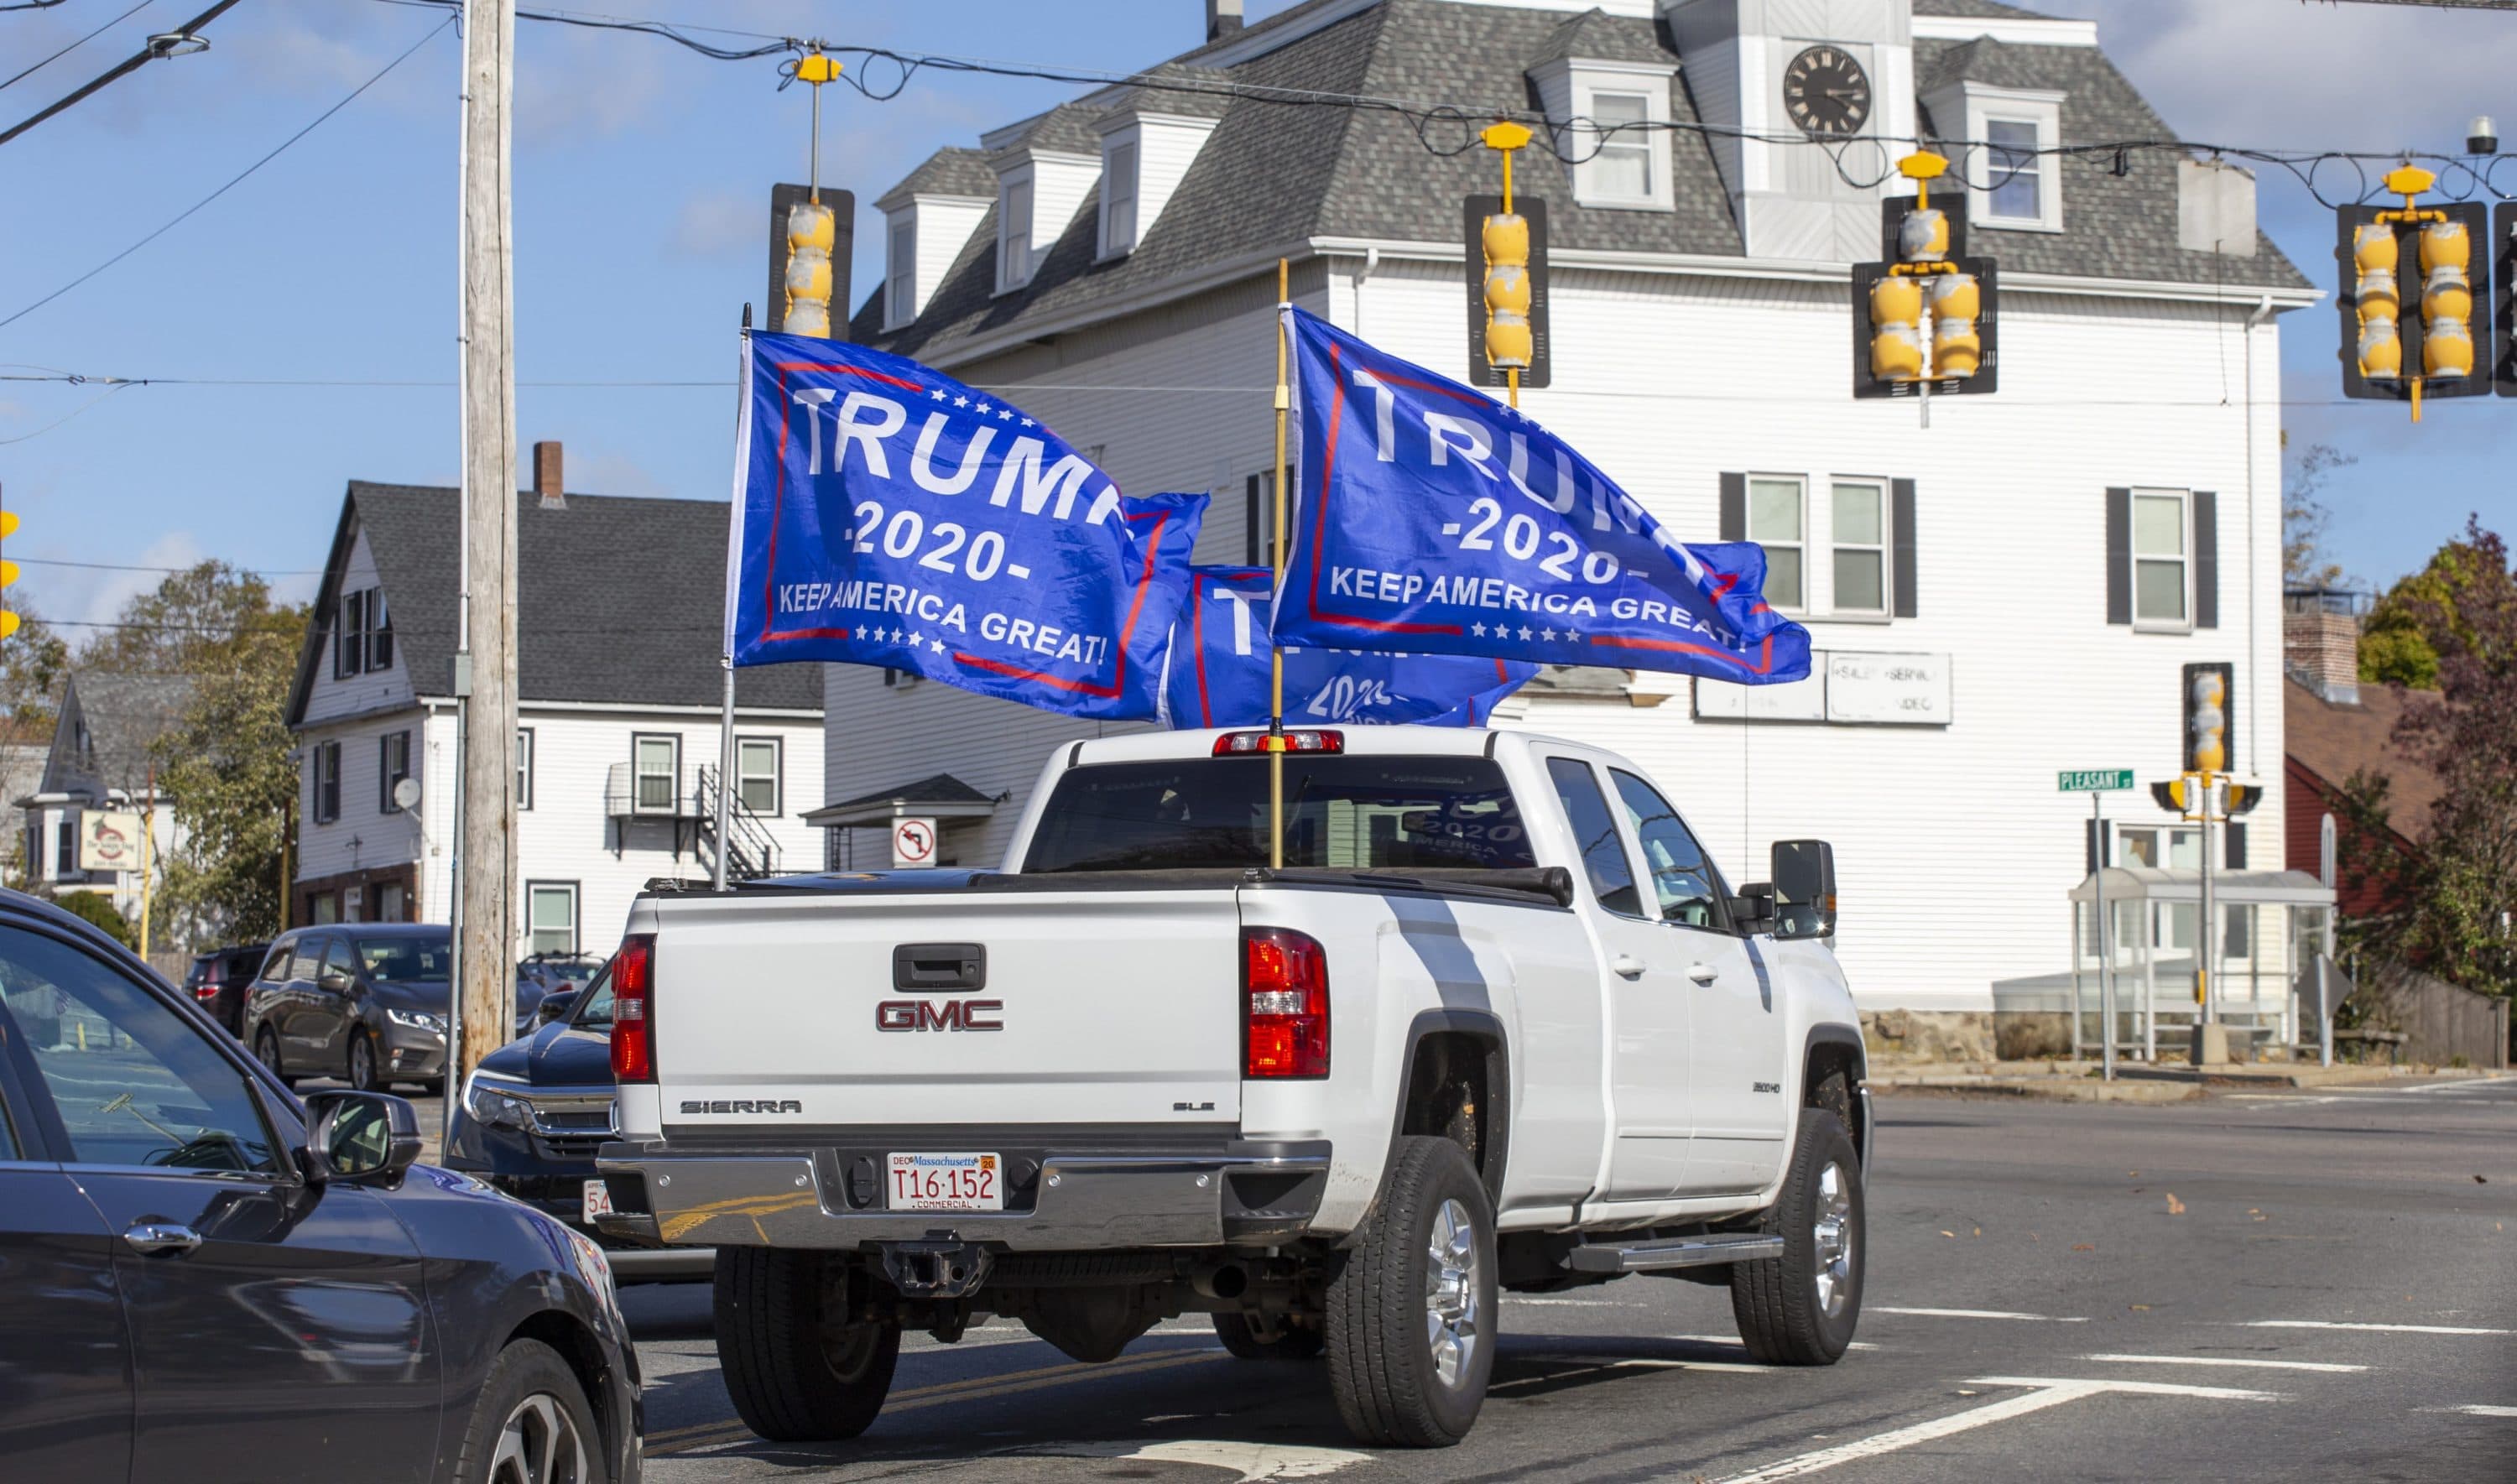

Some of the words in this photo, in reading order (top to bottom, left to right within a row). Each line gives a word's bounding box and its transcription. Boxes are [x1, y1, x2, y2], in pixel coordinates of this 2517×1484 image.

[845, 501, 1032, 581] -2020-
[1442, 497, 1650, 585] -2020-
[1331, 566, 1425, 604] KEEP
[1425, 575, 1597, 617] AMERICA
[779, 583, 831, 613] KEEP
[829, 581, 967, 633] AMERICA
[980, 612, 1108, 666] GREAT!
[2061, 771, 2119, 789] PLEASANT
[876, 999, 1004, 1032] GMC
[680, 1101, 801, 1114] SIERRA
[1173, 1102, 1215, 1111] SLE
[893, 1156, 910, 1165] DEC
[913, 1155, 976, 1167] Massachusetts
[983, 1160, 994, 1169] 20
[917, 1200, 973, 1209] COMMERCIAL
